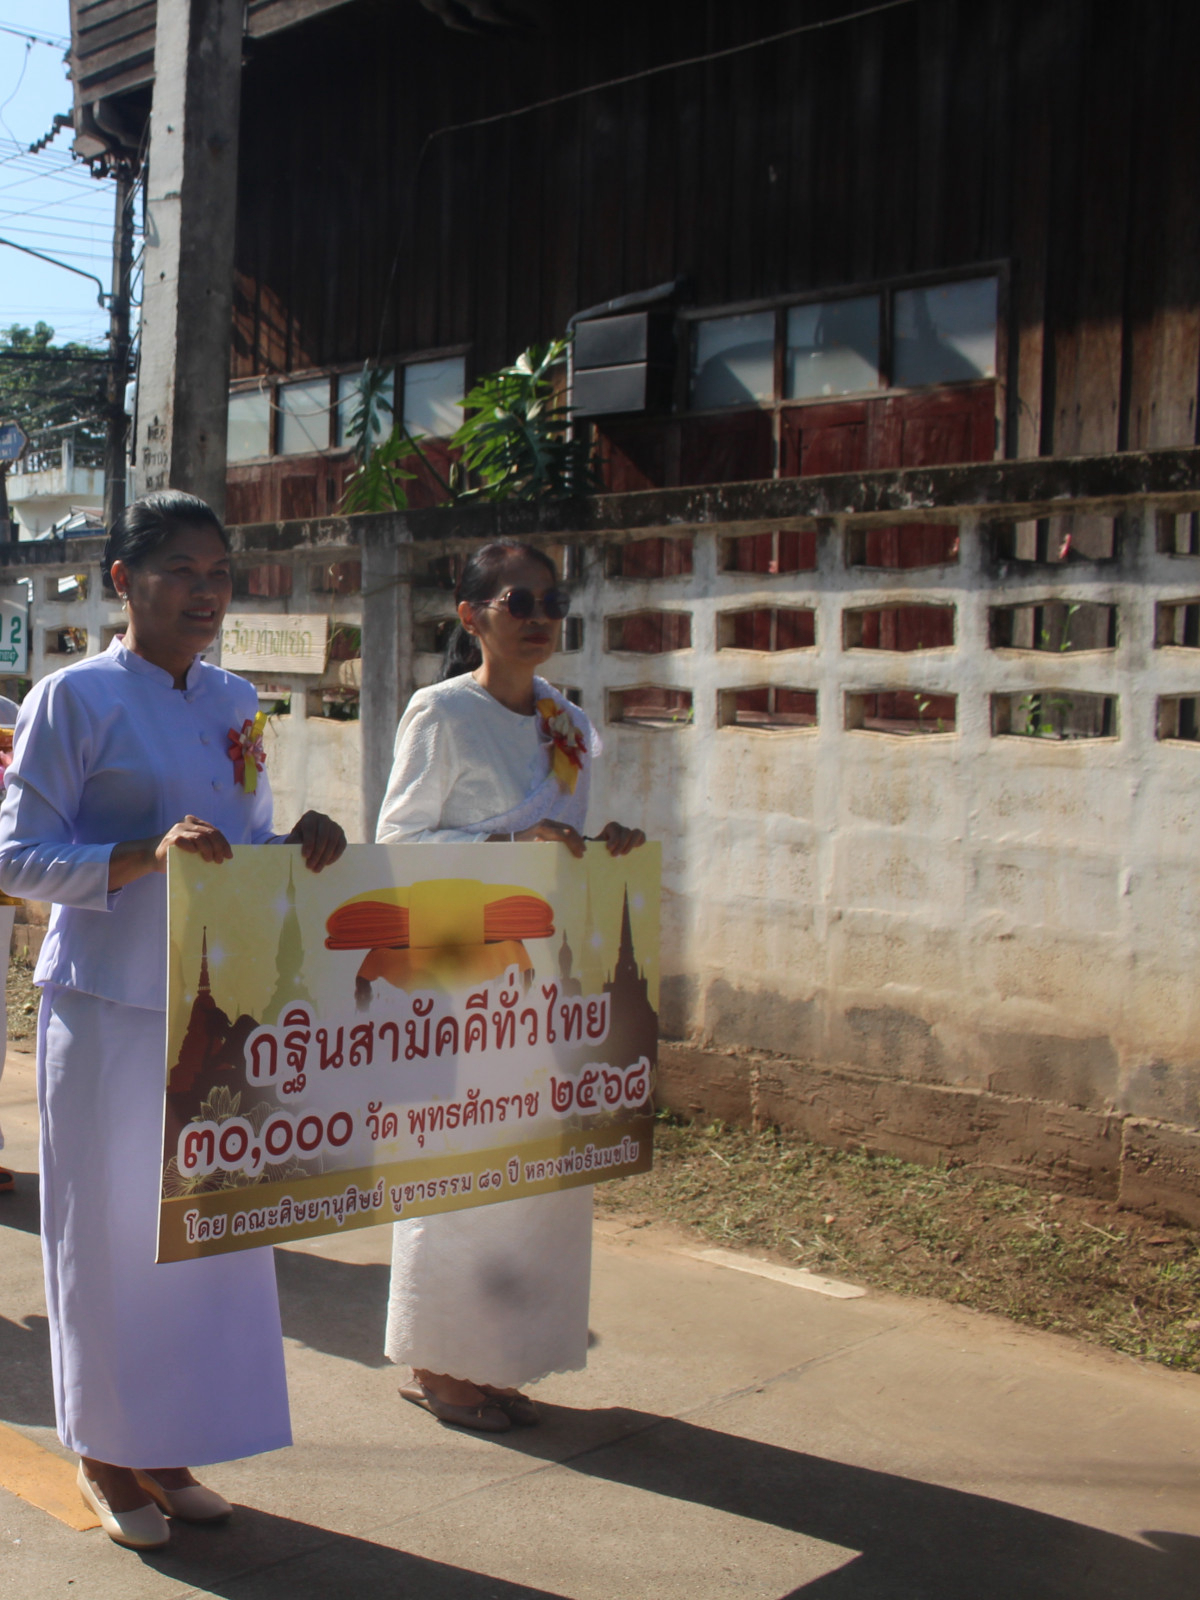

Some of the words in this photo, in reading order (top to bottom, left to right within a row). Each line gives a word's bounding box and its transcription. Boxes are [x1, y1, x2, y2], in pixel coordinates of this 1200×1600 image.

[10, 616, 21, 644] 2
[250, 971, 606, 1095] กฐินสามัคคีทั่วไทย
[184, 1111, 353, 1169] ๓๐,๐๐๐
[366, 1101, 398, 1141] วัด
[408, 1088, 540, 1148] พุทธศักราช
[550, 1063, 647, 1113] ๒๕๖๘
[186, 1213, 225, 1240] โดย
[233, 1180, 385, 1233] คณะศิษยานุศิษย์
[390, 1175, 472, 1213] บูชาธรรม
[508, 1161, 519, 1183] ปี
